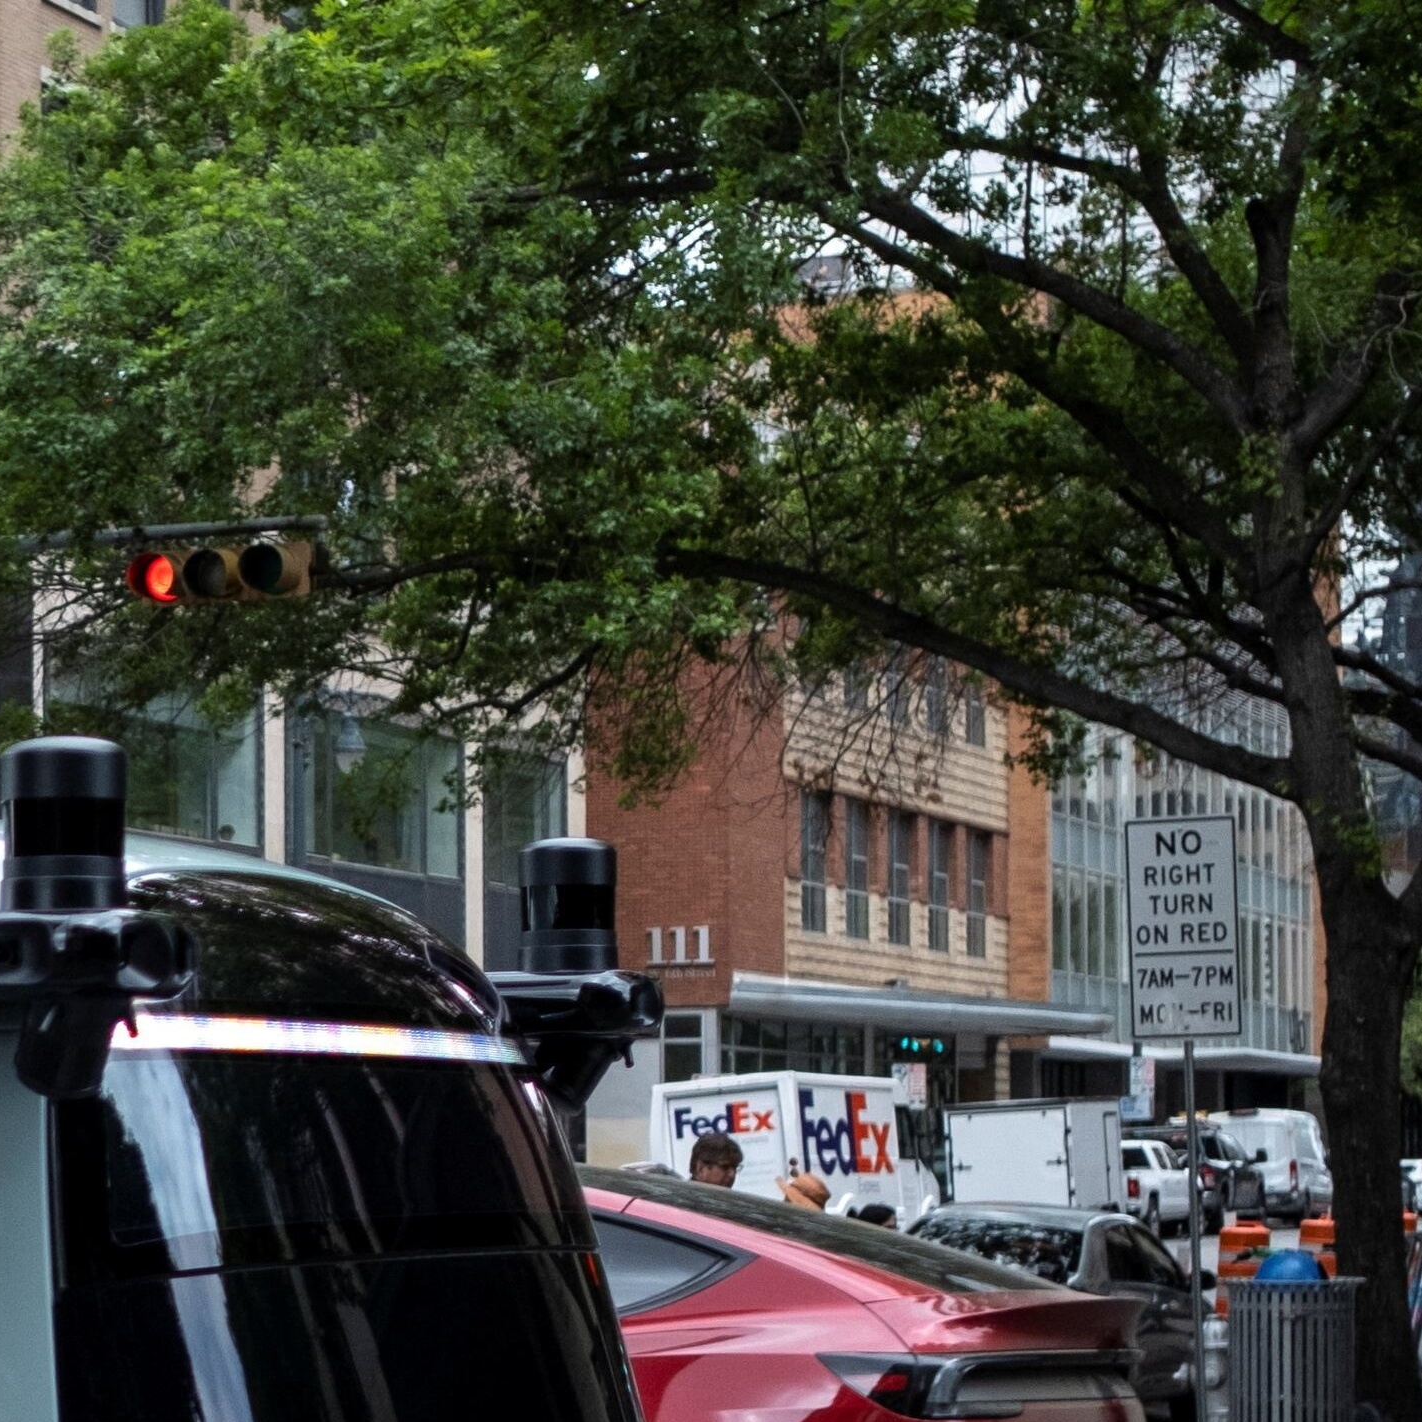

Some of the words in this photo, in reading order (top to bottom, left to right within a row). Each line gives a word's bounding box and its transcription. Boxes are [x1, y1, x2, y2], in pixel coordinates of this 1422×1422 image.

[1156, 829, 1202, 856] NO
[1144, 863, 1216, 886] RIGHT
[1149, 893, 1214, 915] TURN
[646, 924, 715, 966] 111
[1136, 924, 1169, 946] ON
[1180, 921, 1228, 943] RED
[674, 1101, 775, 1139] FedEx
[799, 1089, 895, 1177] FedEx
